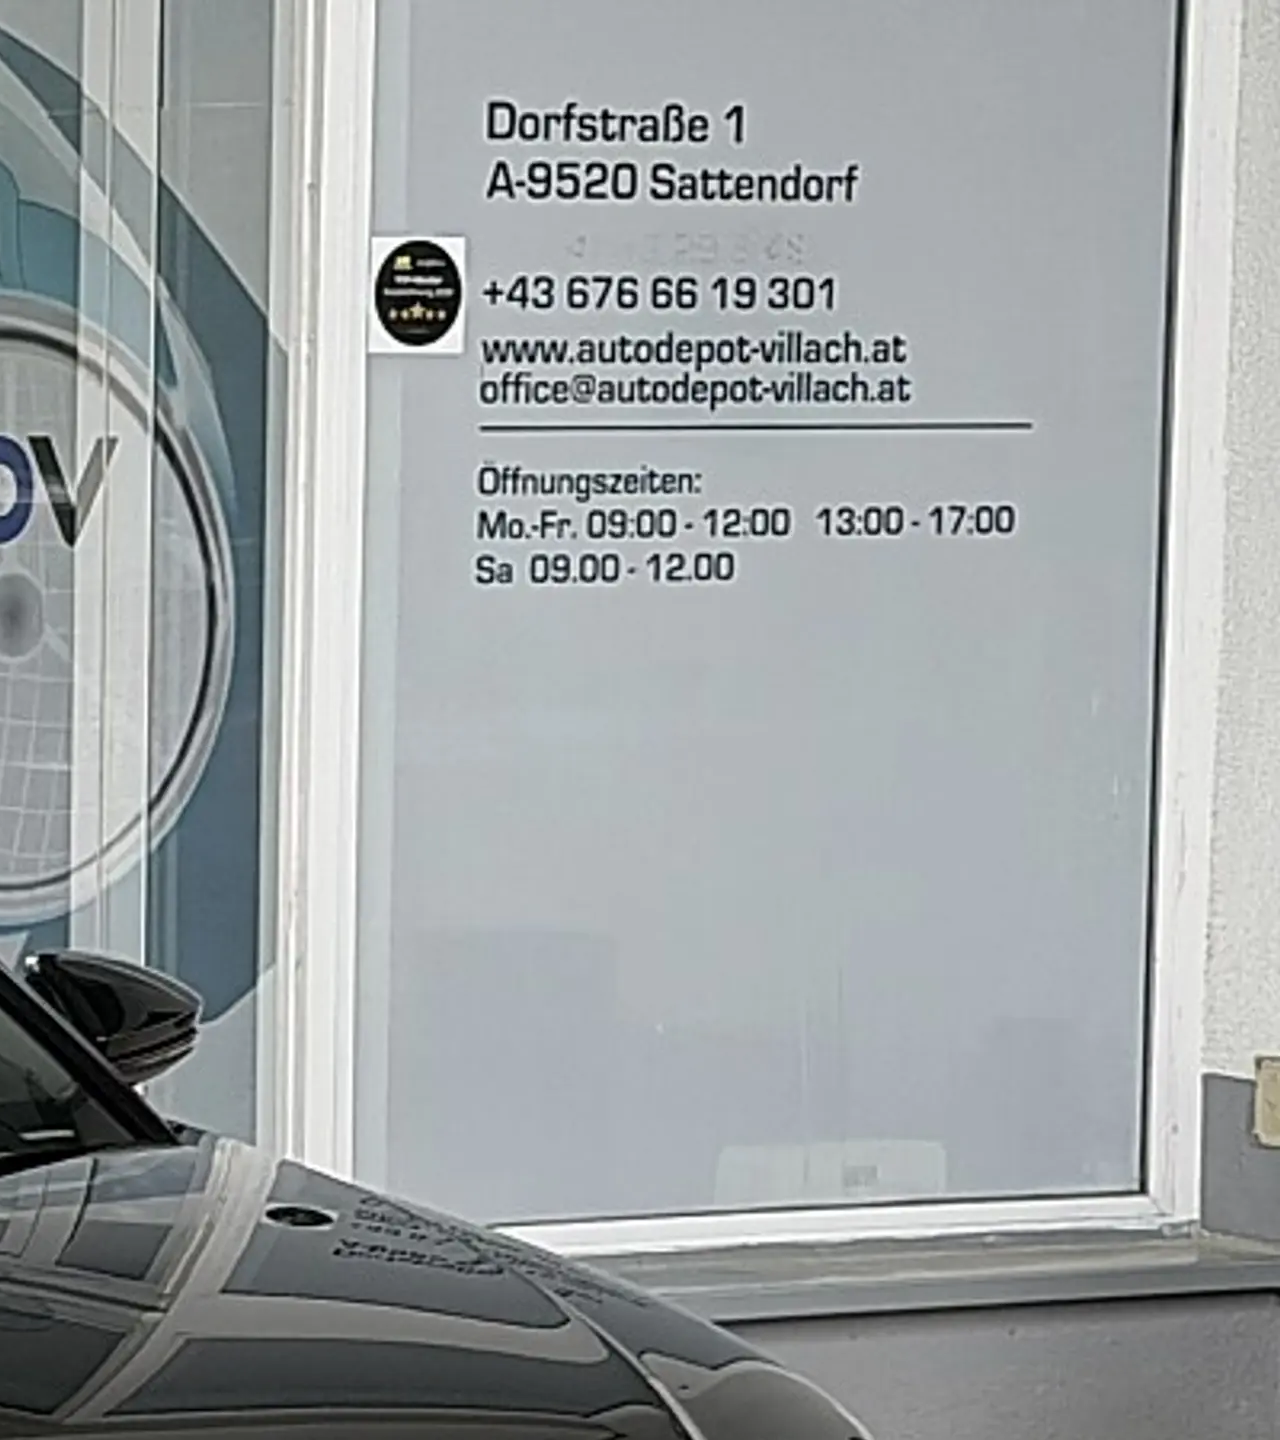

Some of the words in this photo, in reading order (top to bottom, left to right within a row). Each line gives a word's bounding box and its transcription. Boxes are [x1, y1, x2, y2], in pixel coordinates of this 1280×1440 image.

[486, 101, 710, 144] Dorfstraße
[723, 104, 746, 145] 1
[485, 160, 639, 202] A-9520
[648, 162, 860, 203] Sattendorf
[482, 274, 555, 310] +43
[566, 274, 640, 310] 676
[650, 275, 699, 310] 66
[710, 276, 758, 311] 19
[766, 276, 836, 311] 301
[480, 332, 908, 372] www.autodepot-villach.at
[479, 371, 912, 412] office@autodepot-villach.at
[477, 462, 703, 503] Öffnungszeiten:
[476, 509, 578, 541] Mo.-Fr.
[586, 507, 678, 540] 09:00
[702, 507, 792, 538] 12:00
[816, 505, 905, 537] 13:00
[928, 504, 1016, 536] 17:00
[475, 554, 514, 585] Sa
[529, 552, 621, 585] 09.00
[645, 551, 735, 583] 12.00
